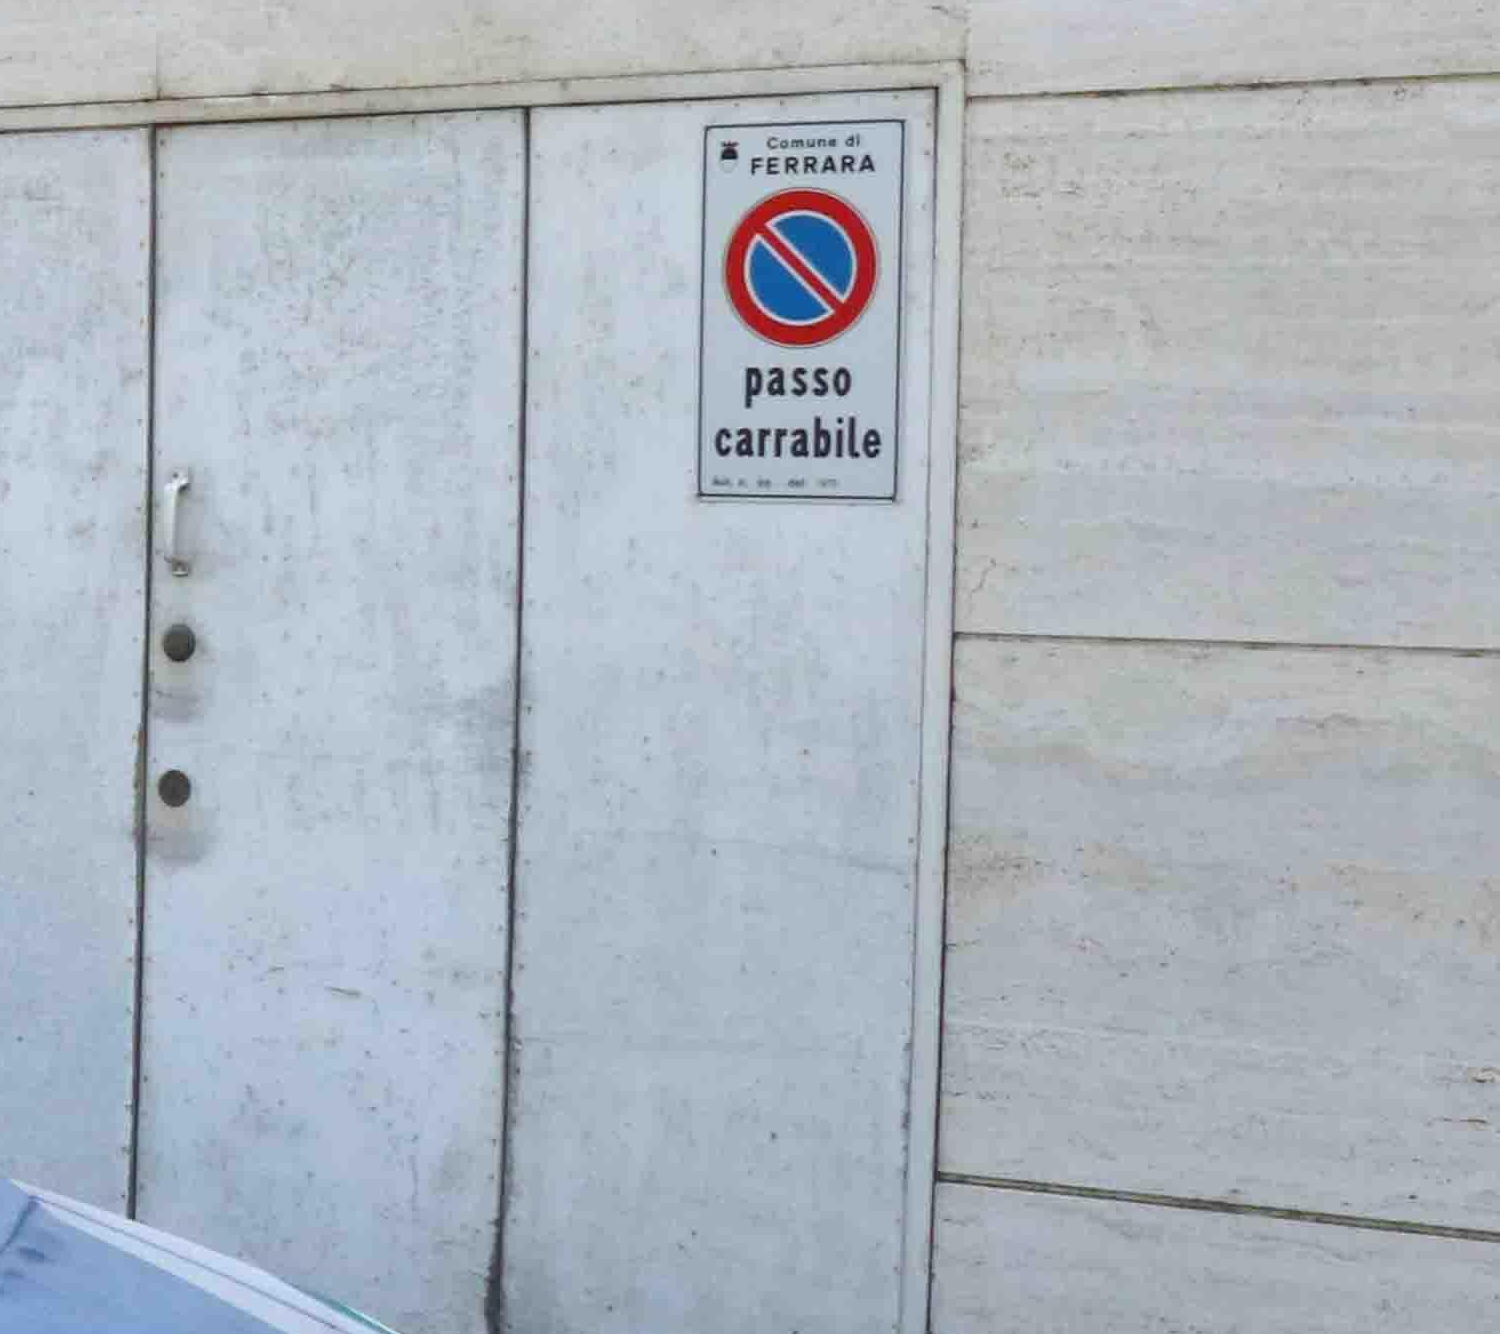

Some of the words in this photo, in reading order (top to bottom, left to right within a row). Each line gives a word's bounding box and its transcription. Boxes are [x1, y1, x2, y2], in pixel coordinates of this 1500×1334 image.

[765, 135, 837, 150] Comune
[844, 134, 861, 148] di
[750, 154, 876, 176] FERRARA
[744, 366, 852, 409] passo
[714, 416, 882, 458] carrabile
